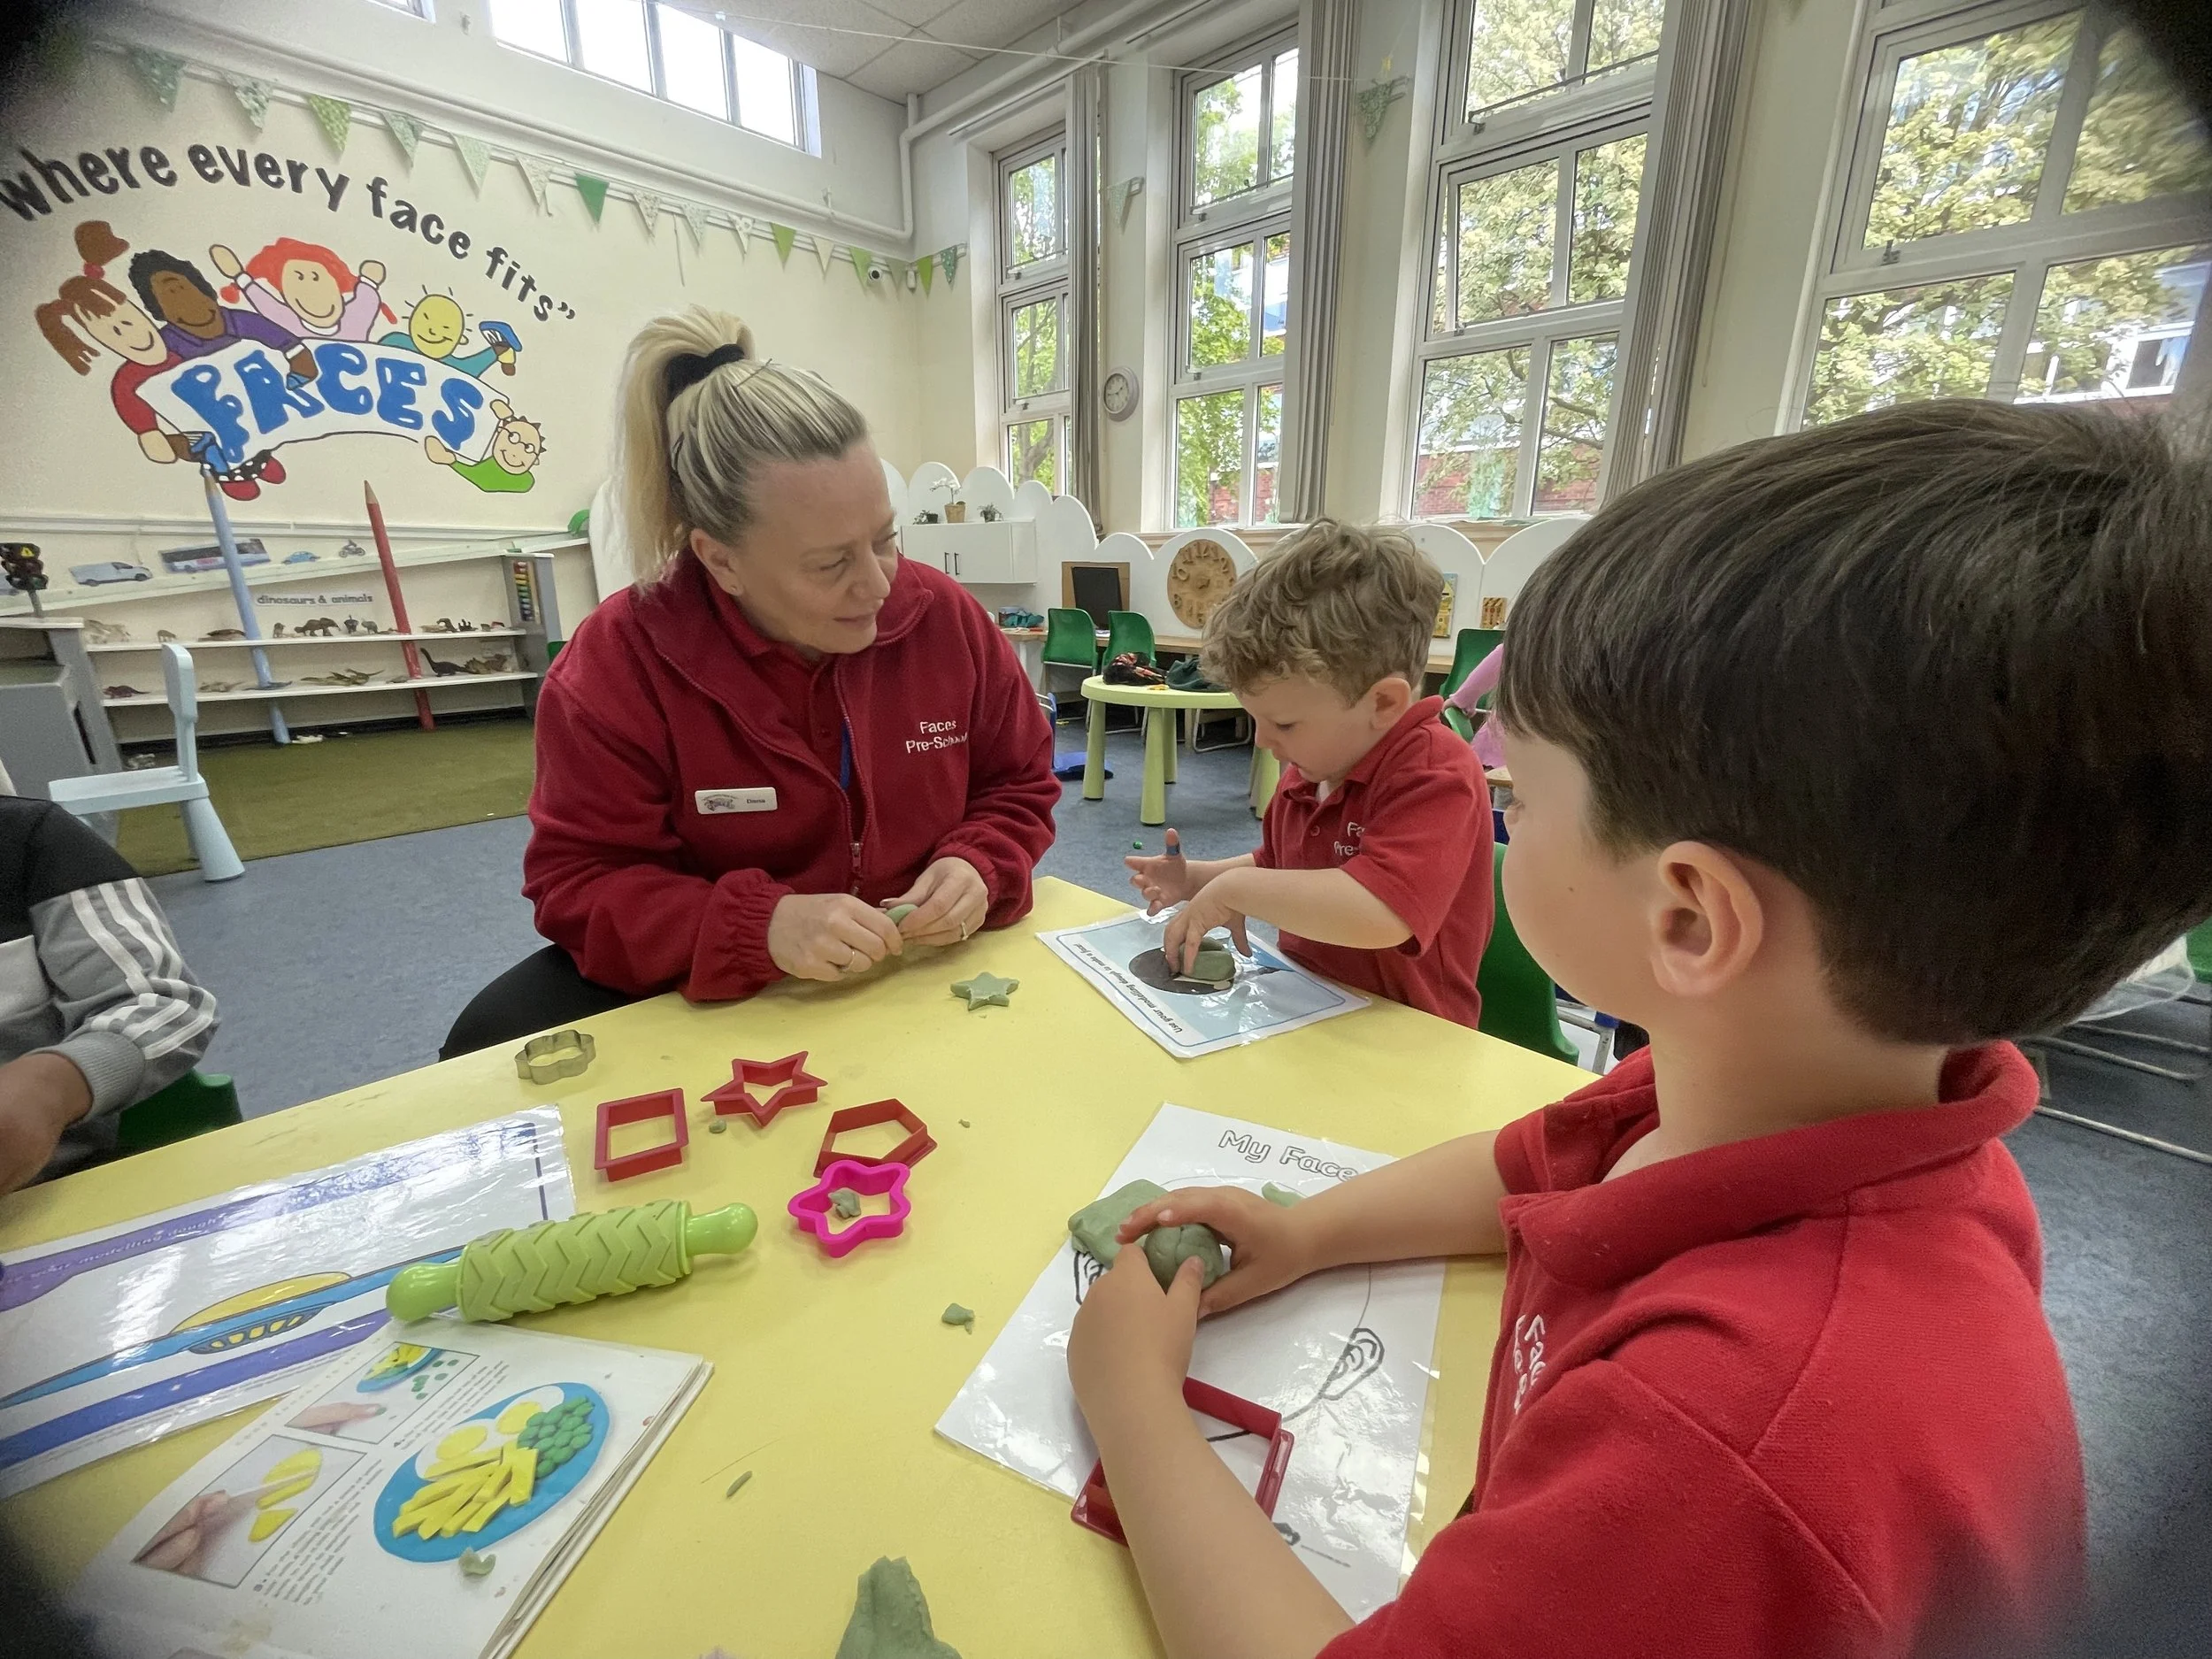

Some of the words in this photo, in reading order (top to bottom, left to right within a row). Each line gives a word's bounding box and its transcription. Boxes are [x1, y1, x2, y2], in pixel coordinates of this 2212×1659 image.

[0, 146, 177, 221] where
[188, 143, 350, 212] every
[365, 176, 471, 259] face
[171, 342, 484, 464] FACES
[257, 595, 316, 604] dinosaurs
[319, 595, 327, 603] &
[331, 594, 373, 603] animals
[920, 720, 956, 734] Faces
[1153, 1009, 1172, 1023] your
[1168, 1022, 1183, 1033] Use
[1218, 1130, 1271, 1164] My
[1279, 1146, 1358, 1182] Face
